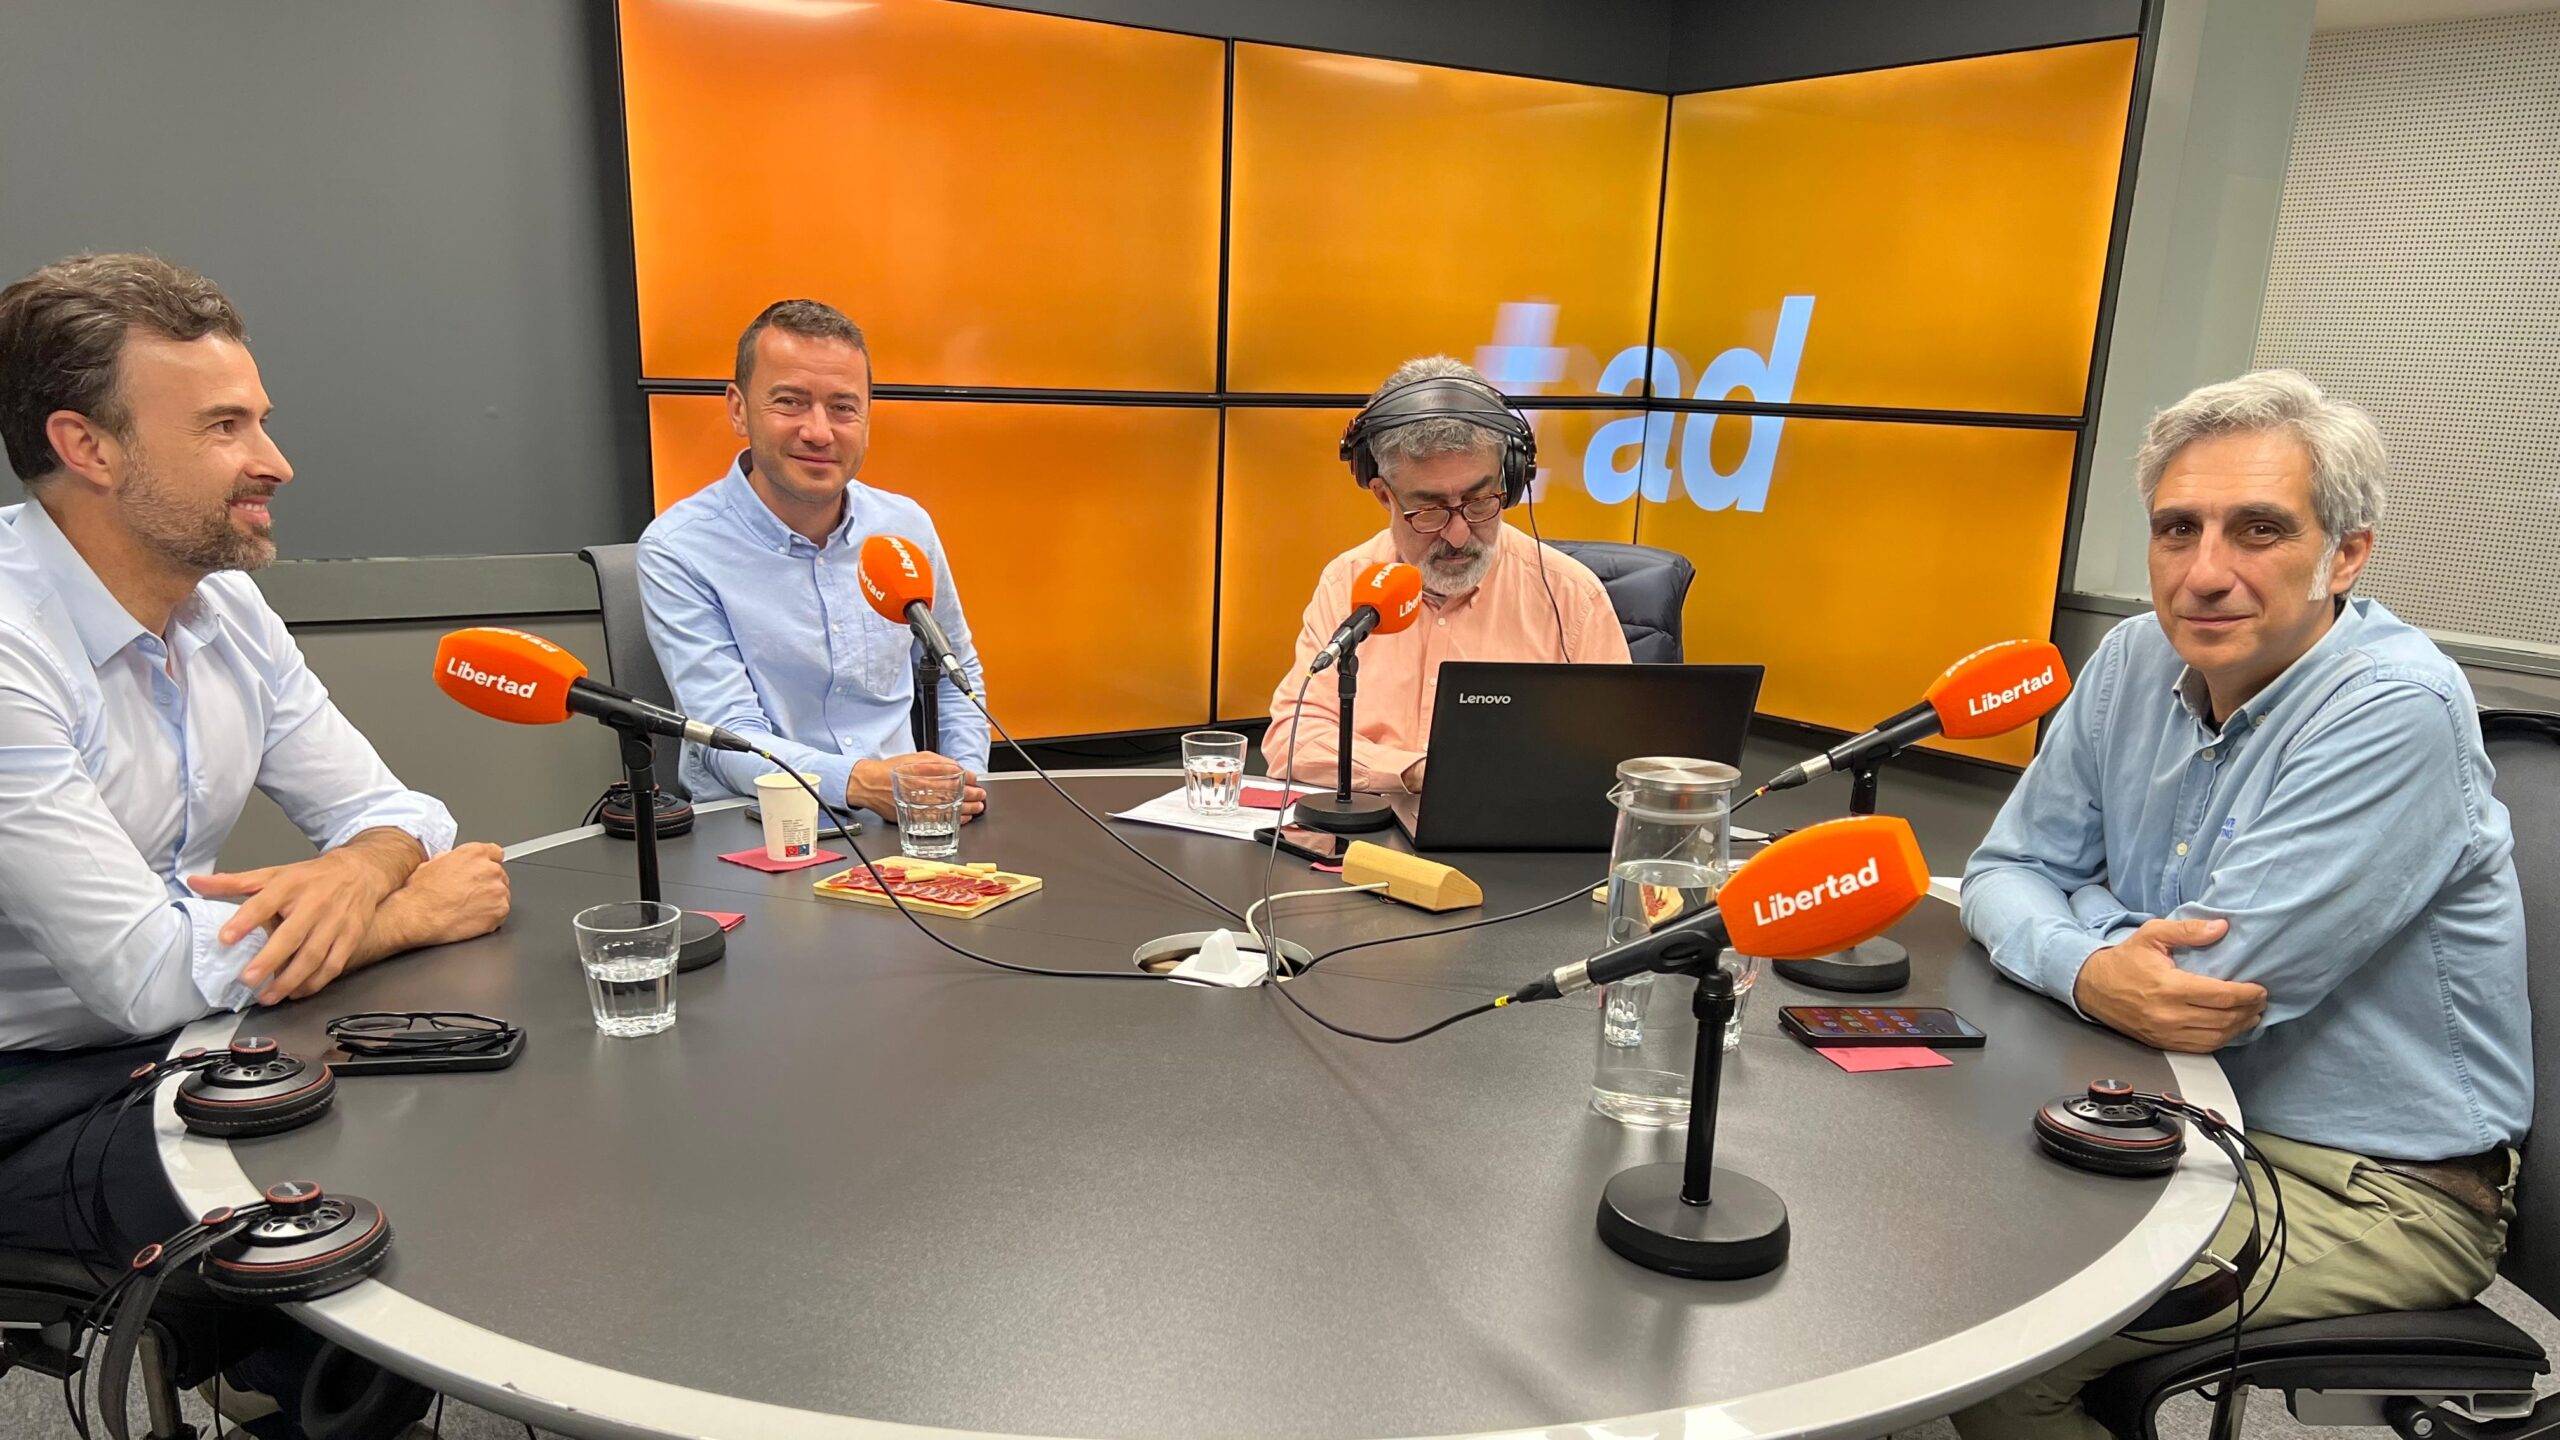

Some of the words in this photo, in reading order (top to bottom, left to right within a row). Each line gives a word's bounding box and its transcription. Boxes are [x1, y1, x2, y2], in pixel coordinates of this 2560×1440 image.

[446, 656, 538, 700] Libertad
[1459, 692, 1512, 705] Lenovo
[1968, 665, 2055, 717] Libertad
[1753, 856, 1880, 927] Libertad
